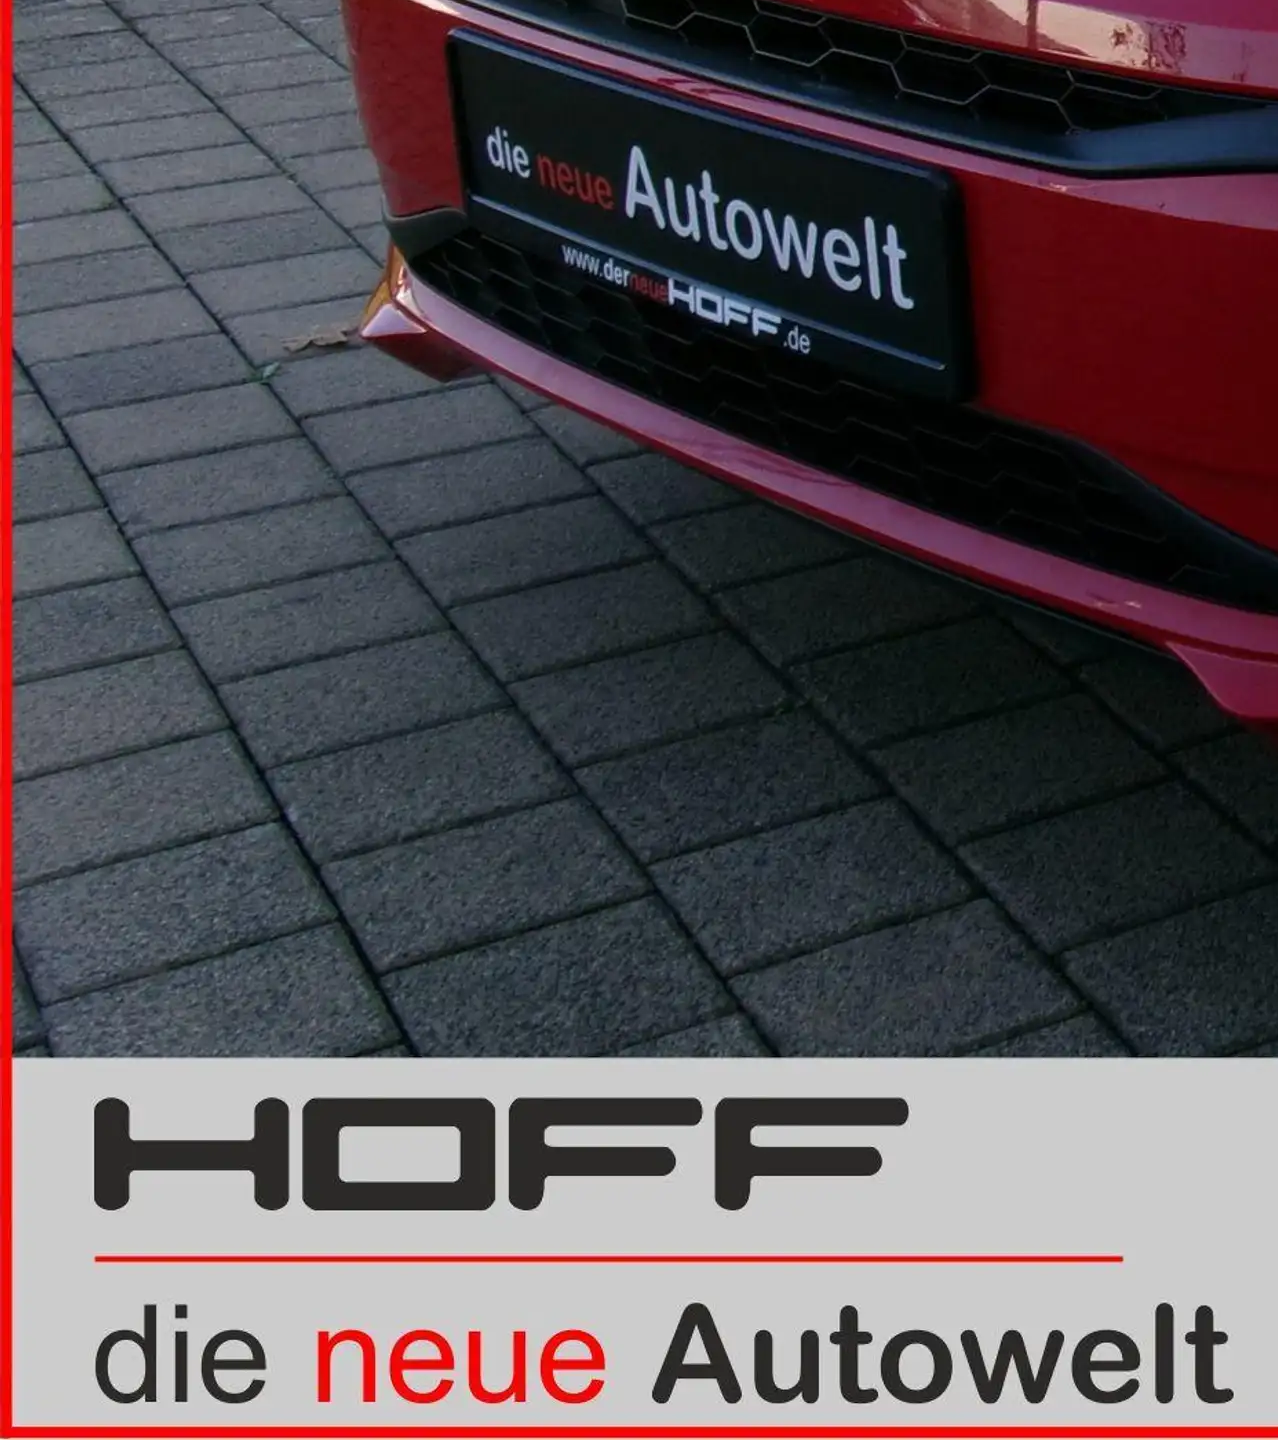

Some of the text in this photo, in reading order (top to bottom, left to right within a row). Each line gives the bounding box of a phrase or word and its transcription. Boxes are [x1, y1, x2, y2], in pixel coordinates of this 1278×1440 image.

[486, 126, 915, 310] die neue Autowelt
